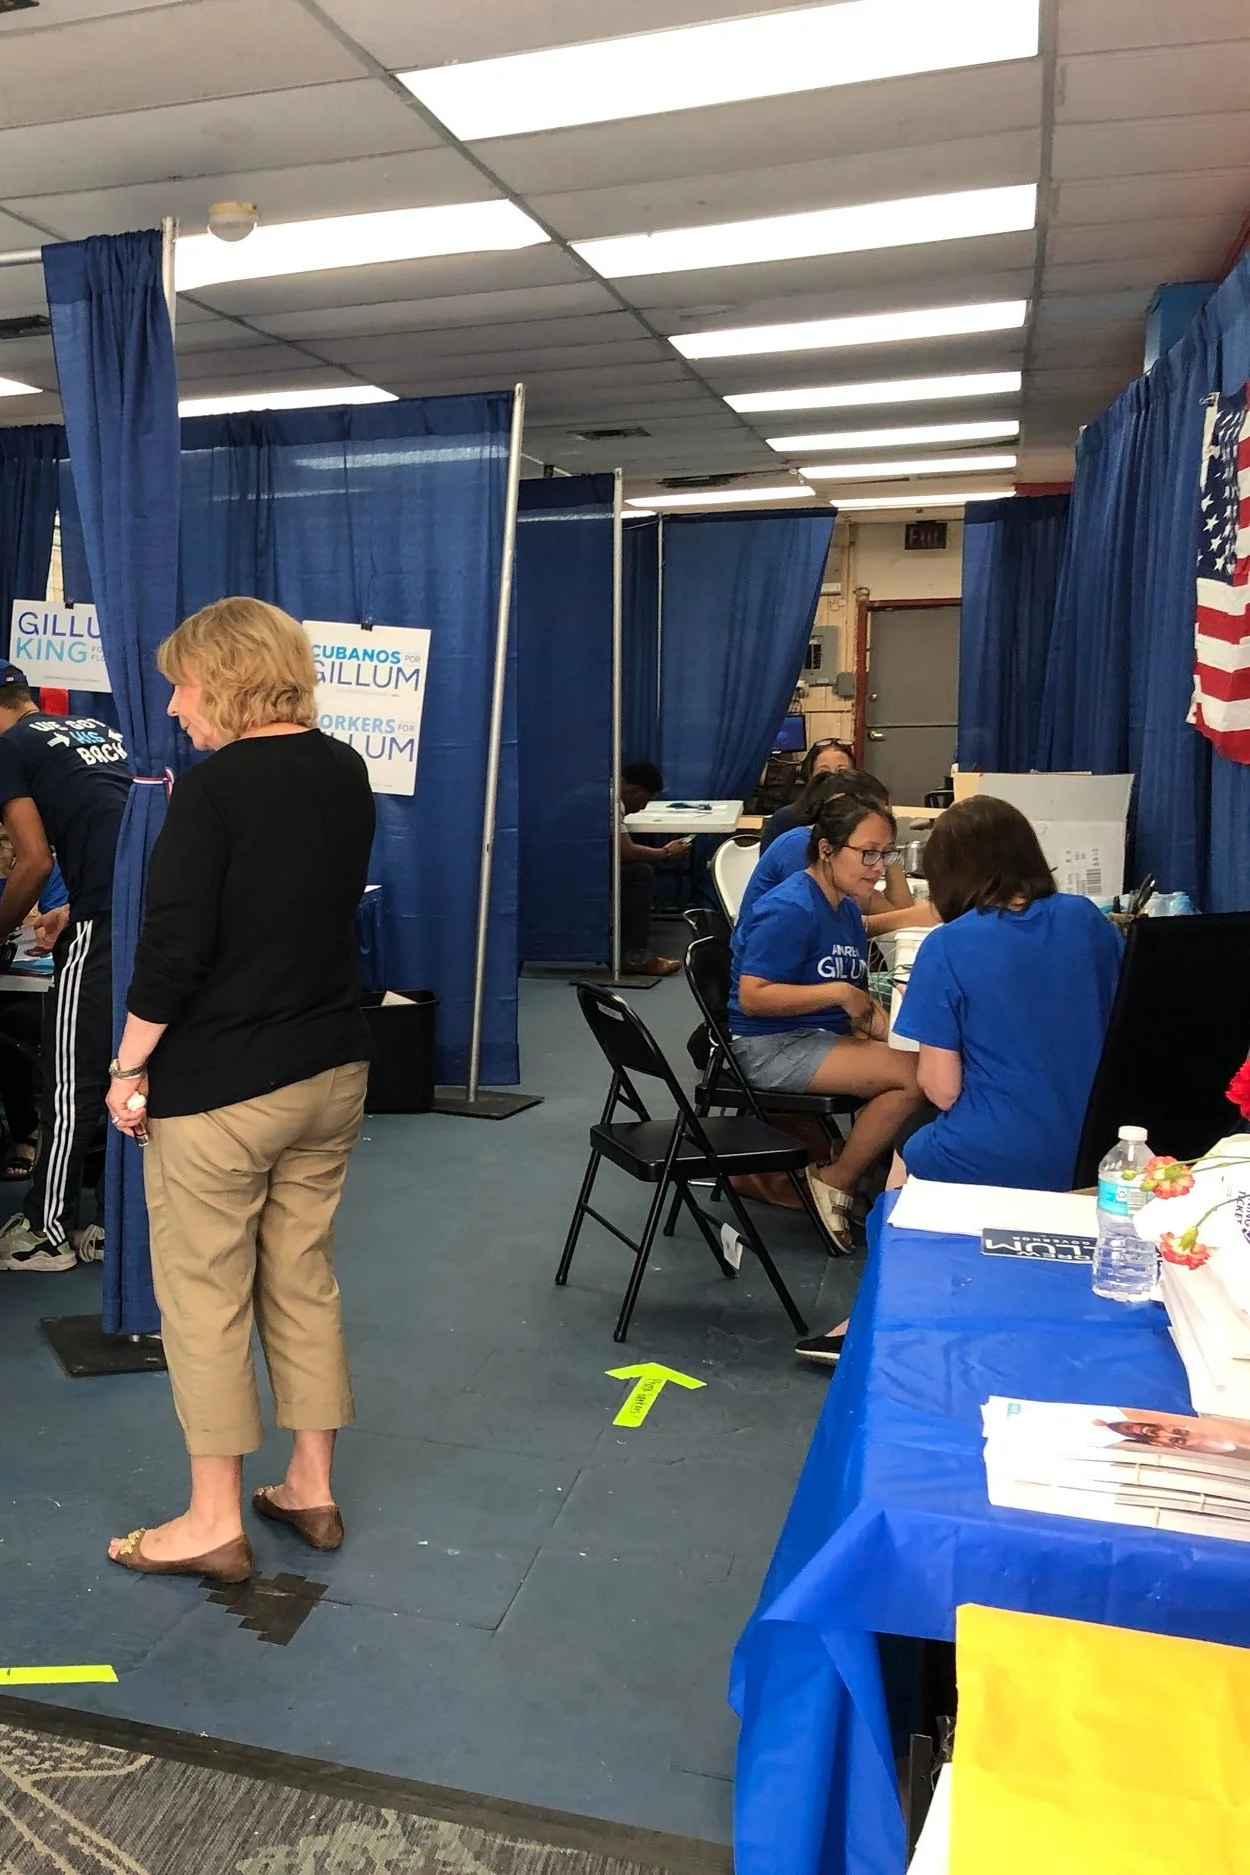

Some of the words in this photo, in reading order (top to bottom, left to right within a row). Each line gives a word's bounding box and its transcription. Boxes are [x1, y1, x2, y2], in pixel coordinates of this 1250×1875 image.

[16, 637, 87, 663] KING
[311, 644, 401, 664] CUBANOS
[404, 655, 421, 664] POR
[314, 660, 421, 691] GILLUM
[29, 721, 68, 731] WE
[65, 718, 106, 730] GOT
[398, 724, 414, 732] FOR
[69, 731, 105, 744] HIS
[76, 742, 127, 765] BACK
[1013, 1236, 1090, 1246] GOVERNOR
